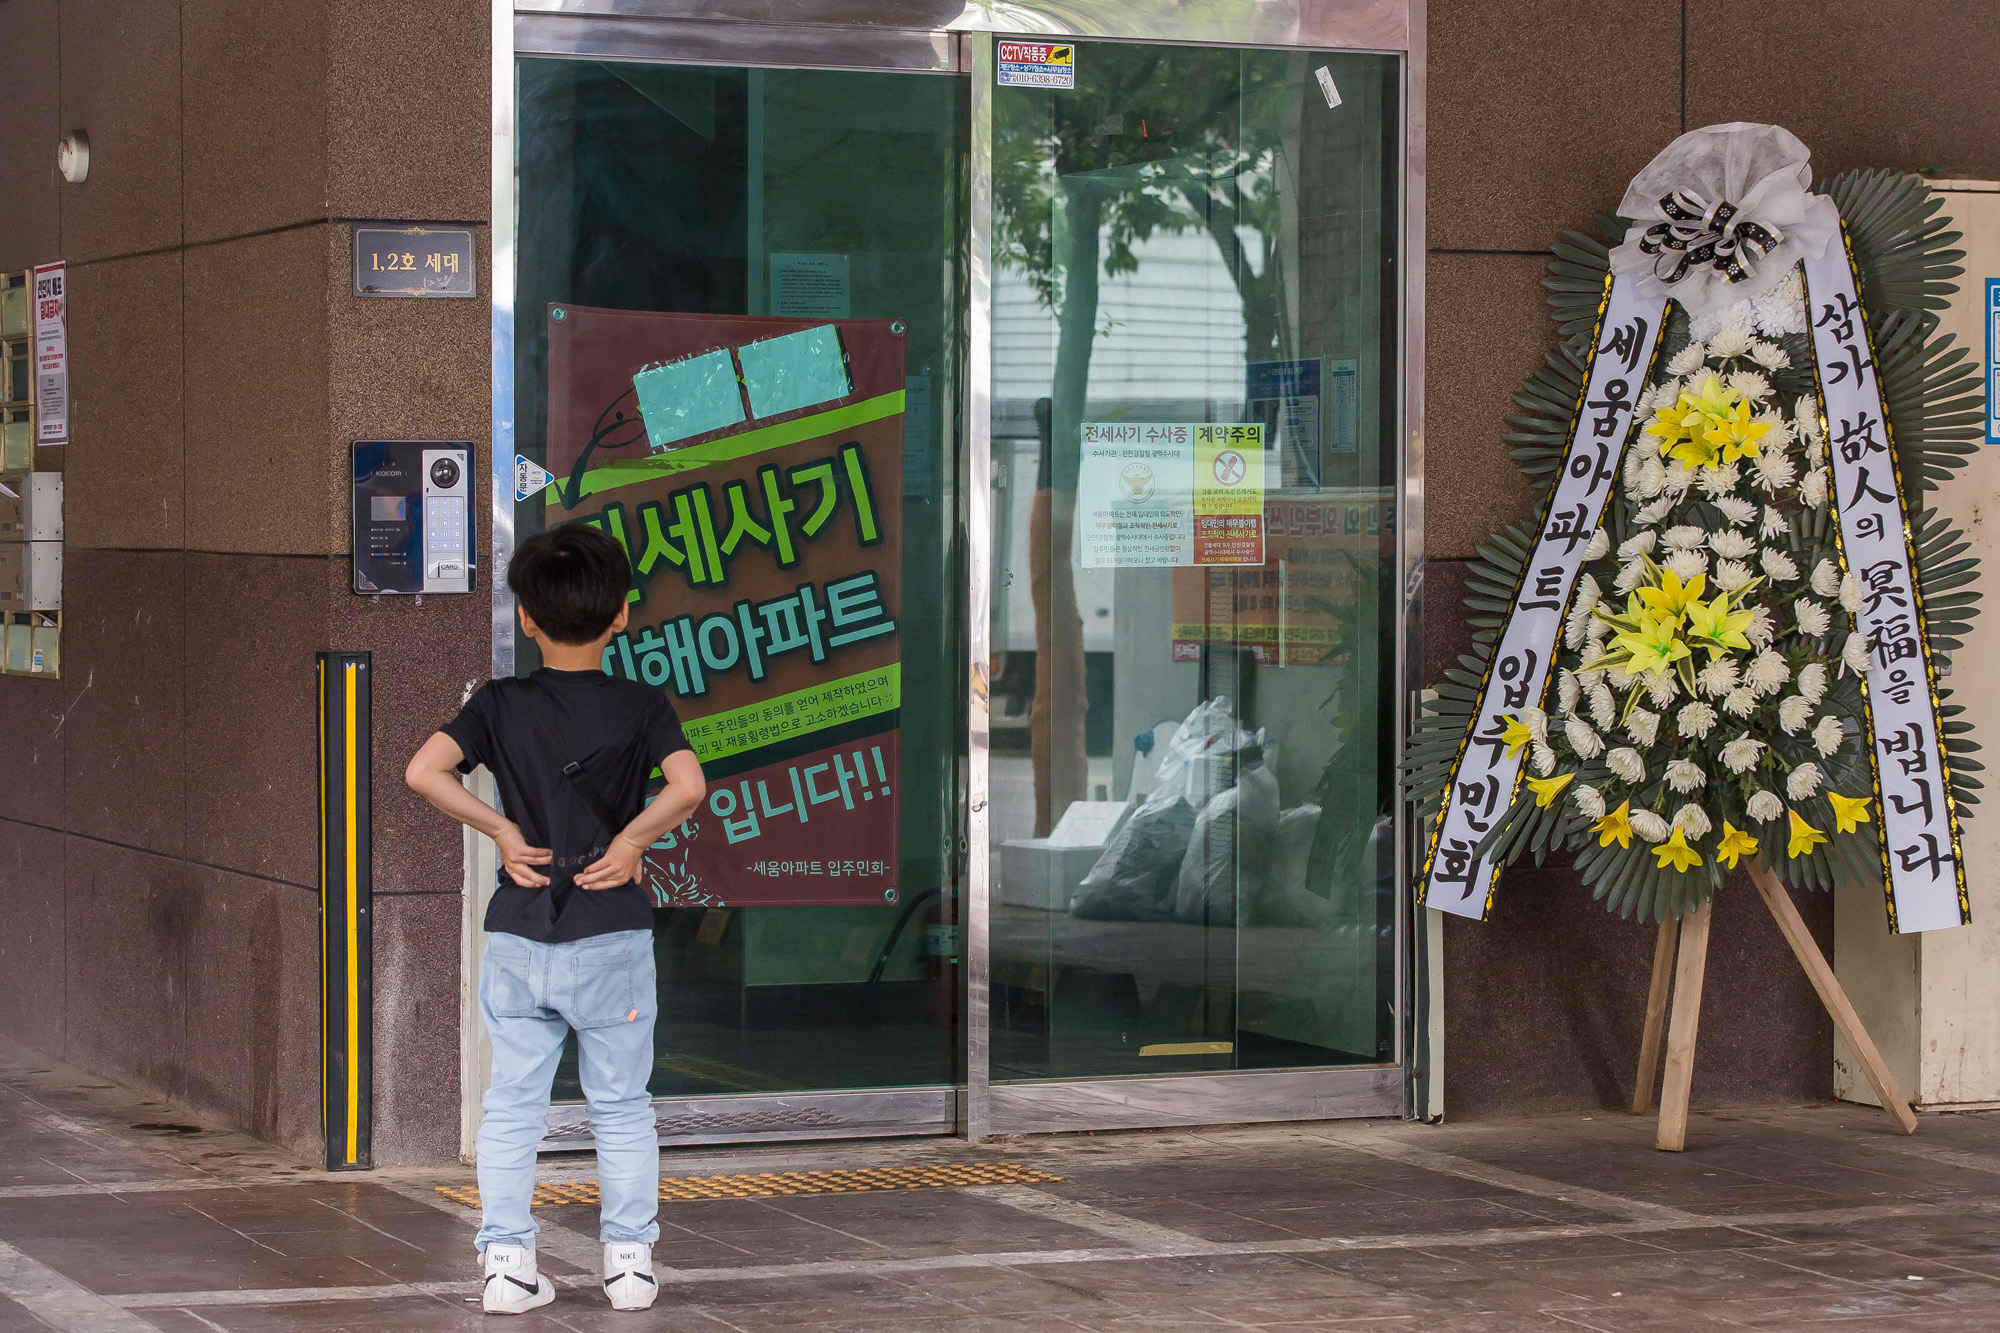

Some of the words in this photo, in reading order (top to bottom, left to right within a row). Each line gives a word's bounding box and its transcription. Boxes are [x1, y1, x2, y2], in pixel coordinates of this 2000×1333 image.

[1001, 46, 1046, 62] CCTV작동중
[372, 253, 416, 272] 1,2호
[425, 253, 458, 273] 세대
[1814, 292, 1872, 391] 삼가
[1086, 426, 1140, 443] 전세사기
[1146, 426, 1188, 443] 수사중
[1122, 450, 1150, 458] 인천경찰청
[1199, 426, 1260, 443] 계약주의
[1518, 316, 1649, 612] 세움아파트
[1833, 411, 1897, 543] 故人의
[1201, 519, 1224, 528] 임대인의
[1226, 519, 1256, 528] 채무불이행
[1201, 530, 1224, 539] 조직적인
[1226, 530, 1258, 539] 전세사기로
[1860, 560, 1918, 704] 冥福을
[711, 740, 723, 753] 및
[726, 718, 802, 748] 재물횡령법으로
[805, 695, 882, 726] 고소하겠습니다
[715, 712, 759, 734] 주민들의
[762, 702, 795, 721] 동의를
[797, 694, 819, 711] 얻어
[822, 675, 889, 703] 제작하였으며
[1434, 648, 1538, 901] 입주민회
[710, 746, 890, 845] 입니다!!
[1878, 722, 1954, 883] 빕니다
[747, 861, 823, 877] -세움아파트
[828, 860, 890, 876] 입주민회-
[620, 1252, 636, 1260] NIKE
